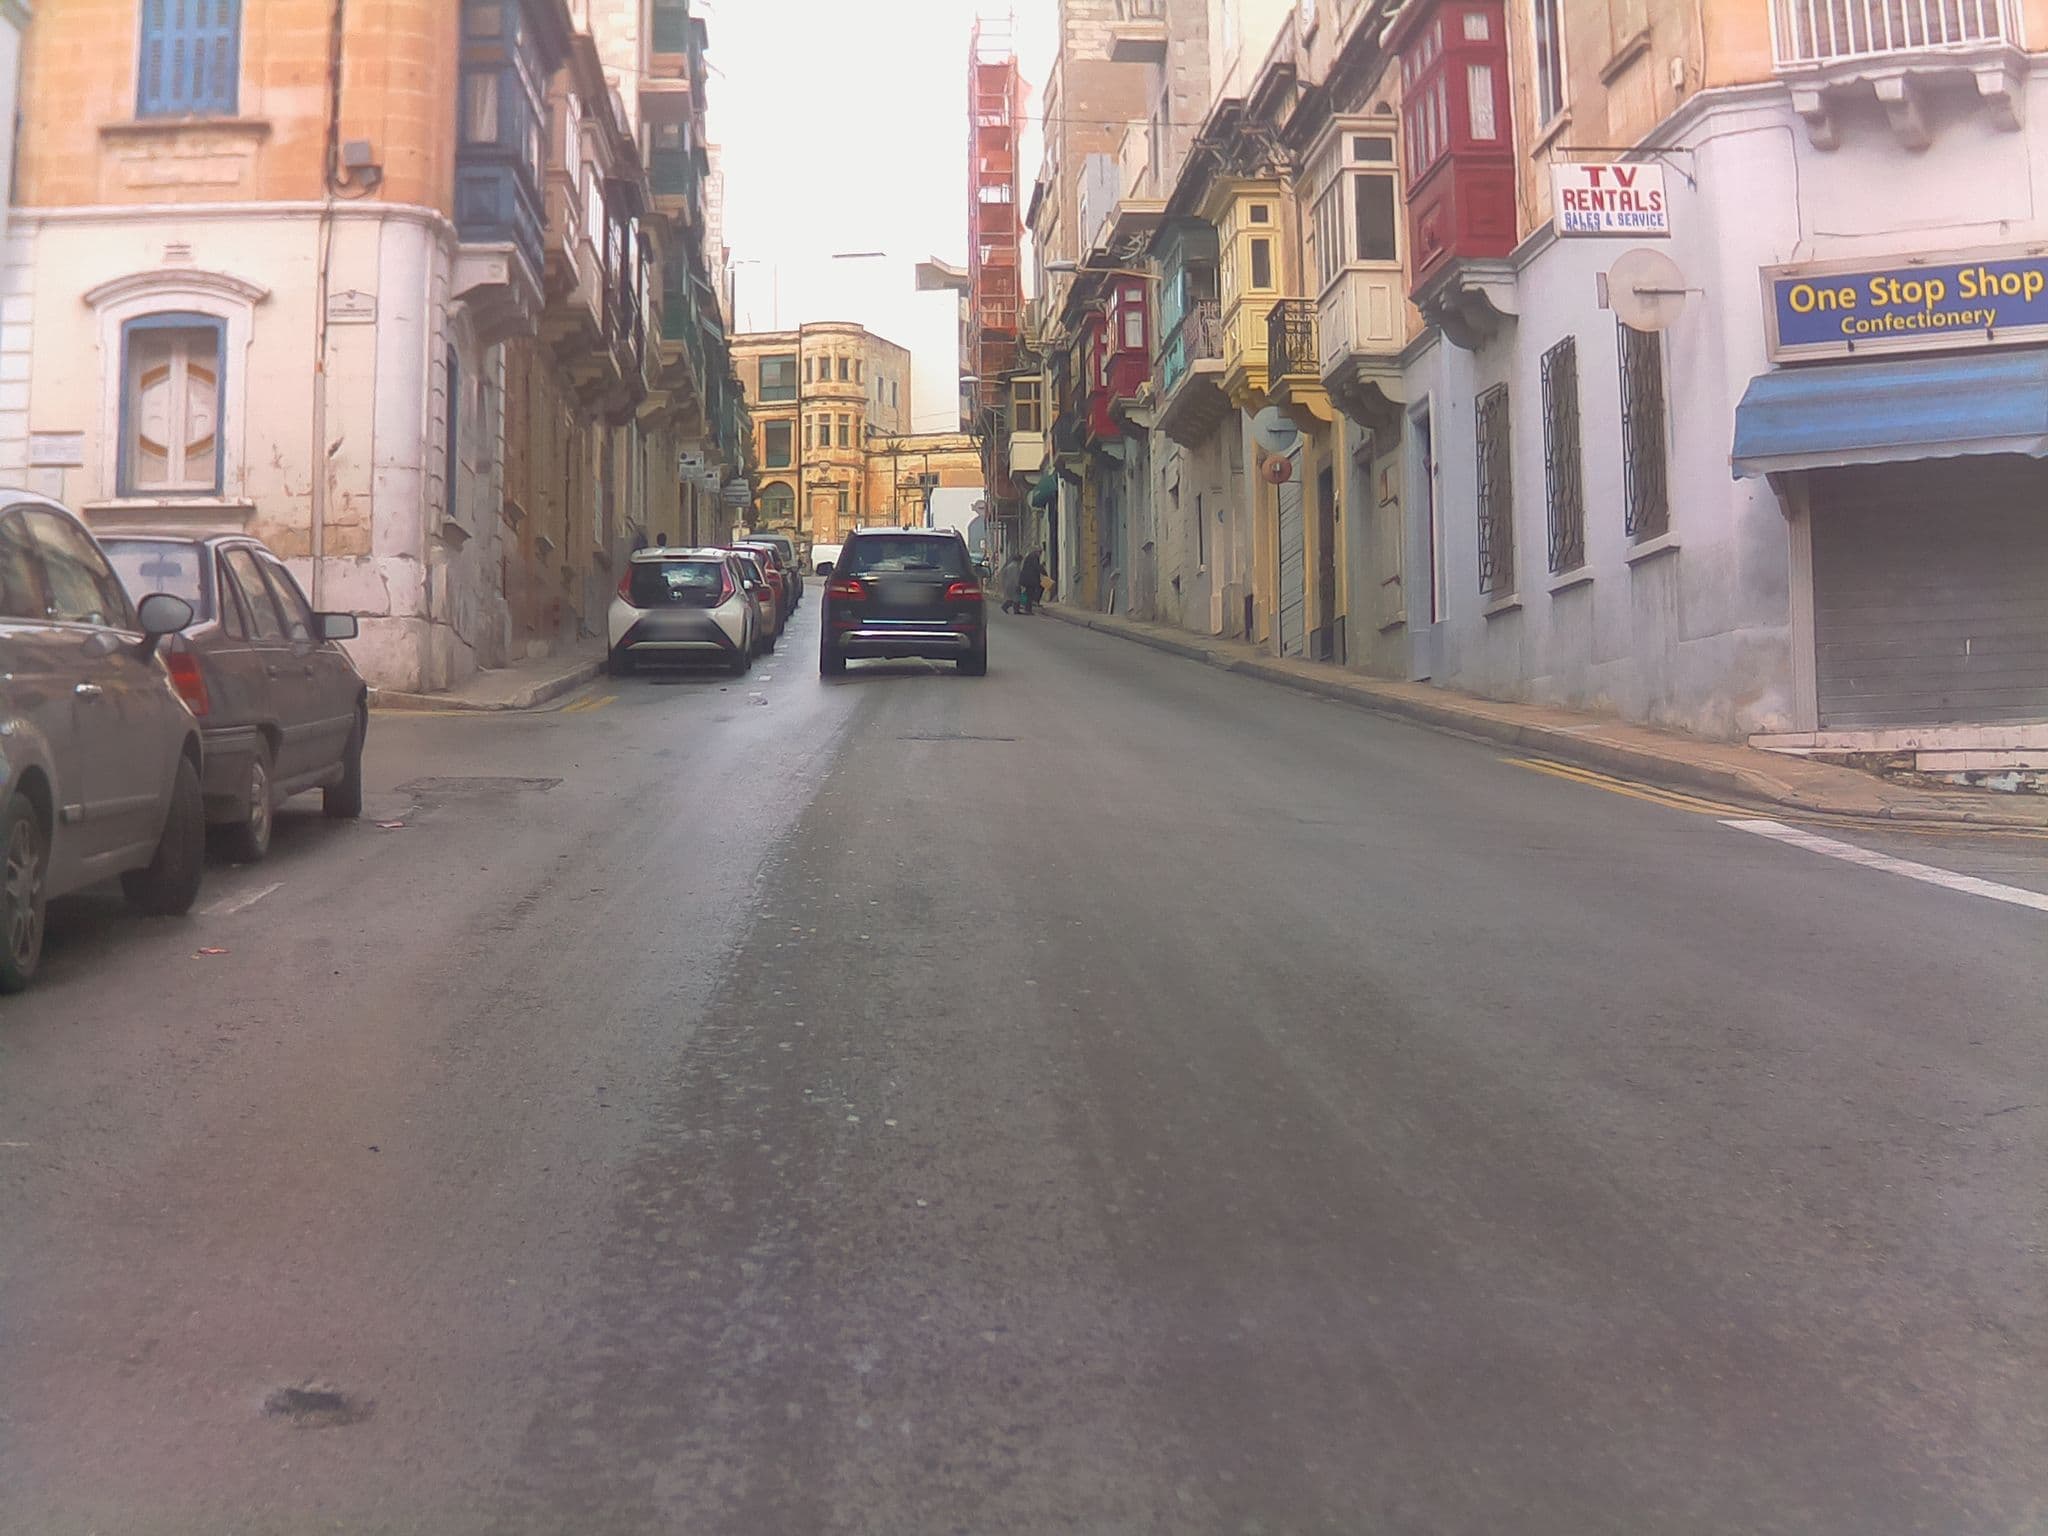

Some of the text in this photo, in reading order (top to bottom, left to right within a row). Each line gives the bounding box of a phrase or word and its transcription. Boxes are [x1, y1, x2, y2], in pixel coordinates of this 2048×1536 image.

[1580, 166, 1637, 188] TV
[1562, 189, 1662, 212] RENTALS
[1565, 212, 1664, 228] SALES & SERVICE
[1788, 267, 2044, 313] One Stop Shop
[1841, 308, 1996, 334] Confectionery
